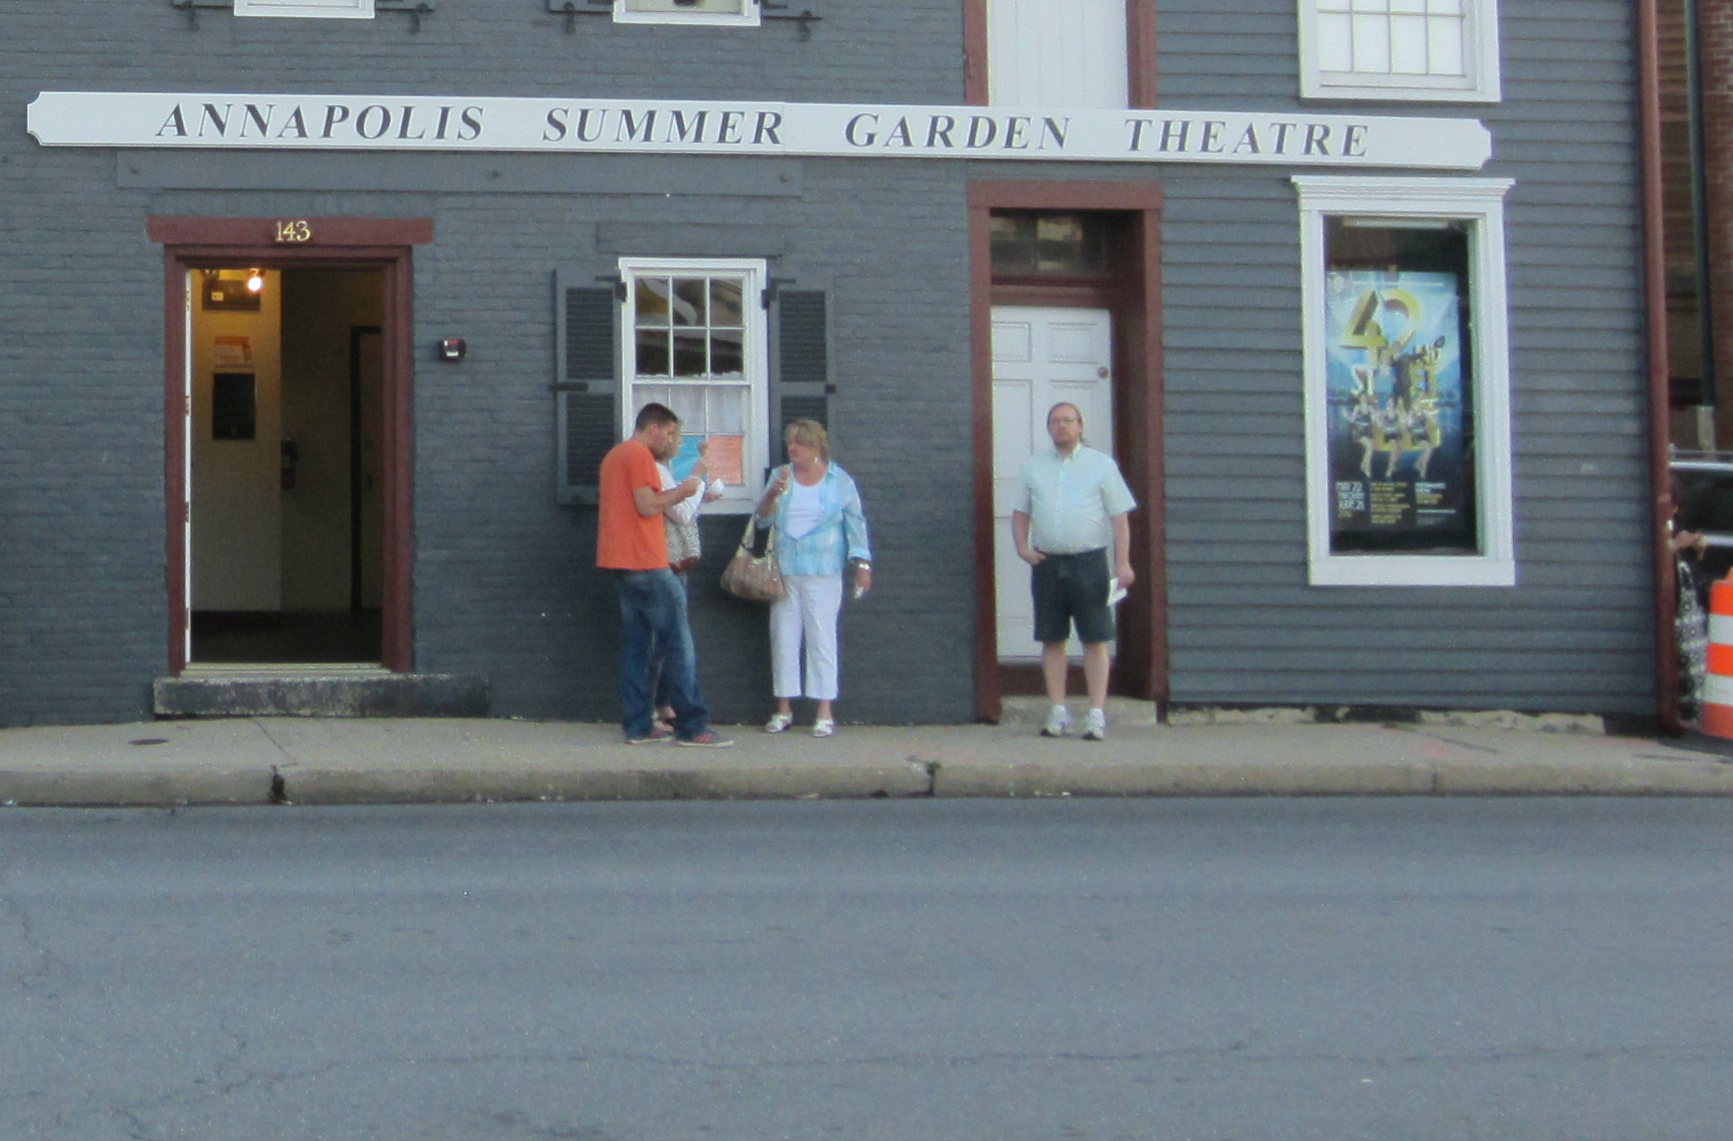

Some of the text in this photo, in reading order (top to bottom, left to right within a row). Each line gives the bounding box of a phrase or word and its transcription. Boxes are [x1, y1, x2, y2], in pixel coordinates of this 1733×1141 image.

[156, 102, 1369, 159] ANNAPOLIS SUMMER GARDEN THEATRE
[275, 221, 310, 241] 143
